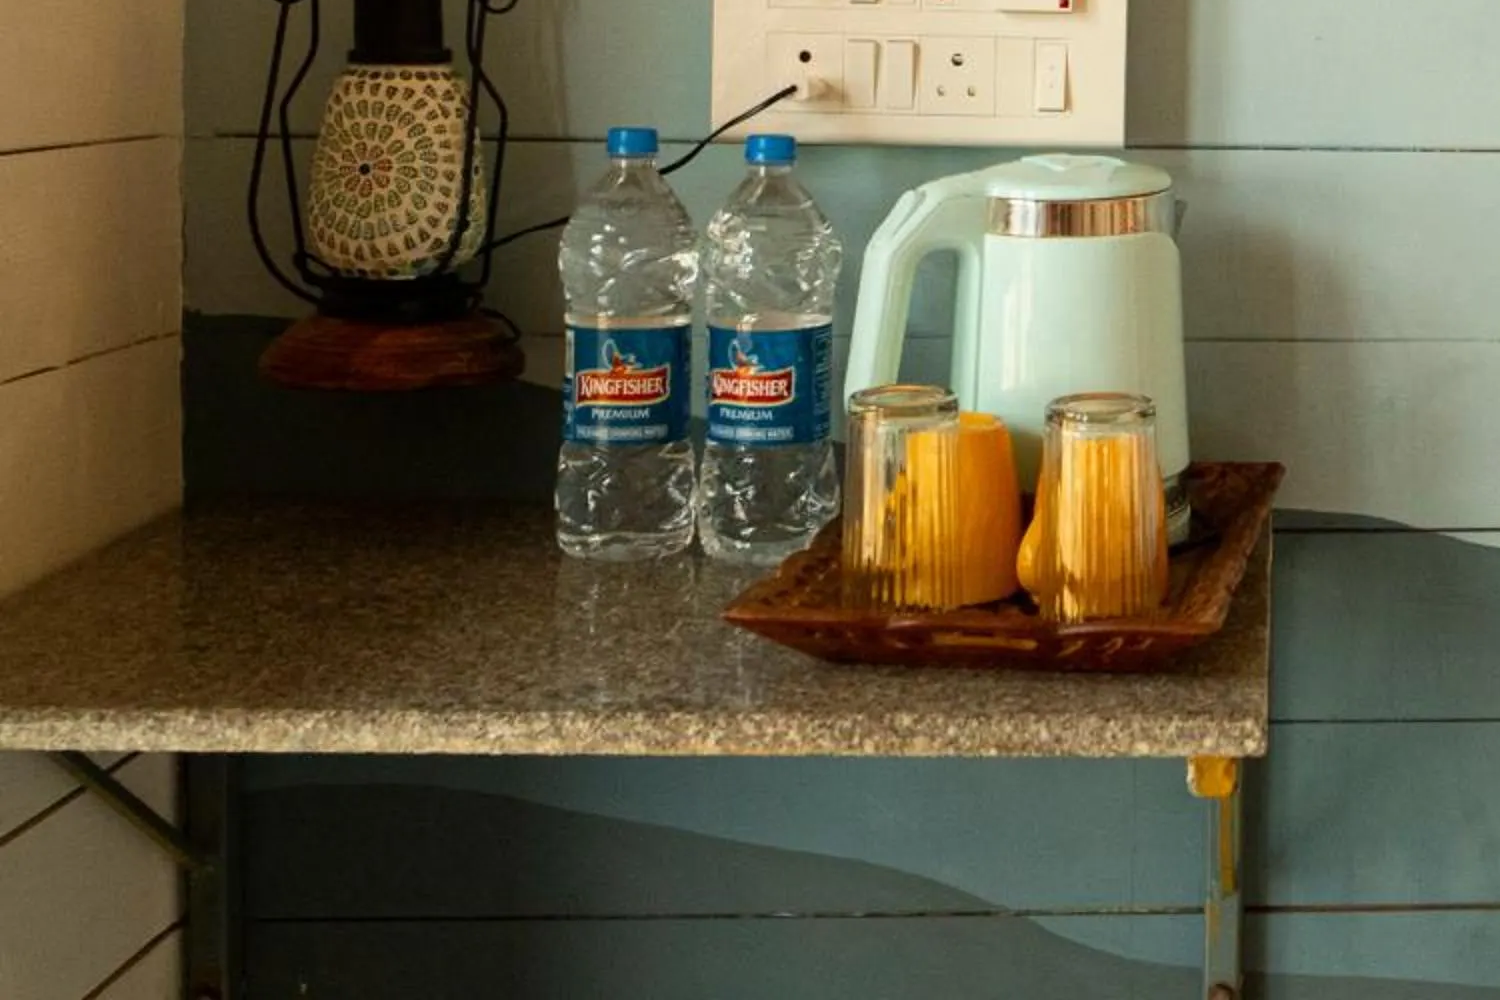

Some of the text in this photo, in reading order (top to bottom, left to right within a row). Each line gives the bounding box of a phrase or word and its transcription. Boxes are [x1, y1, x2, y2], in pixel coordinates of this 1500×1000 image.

[580, 375, 664, 397] KINGFISHER
[591, 407, 651, 420] PREMIUM
[720, 407, 773, 421] PREMIUM
